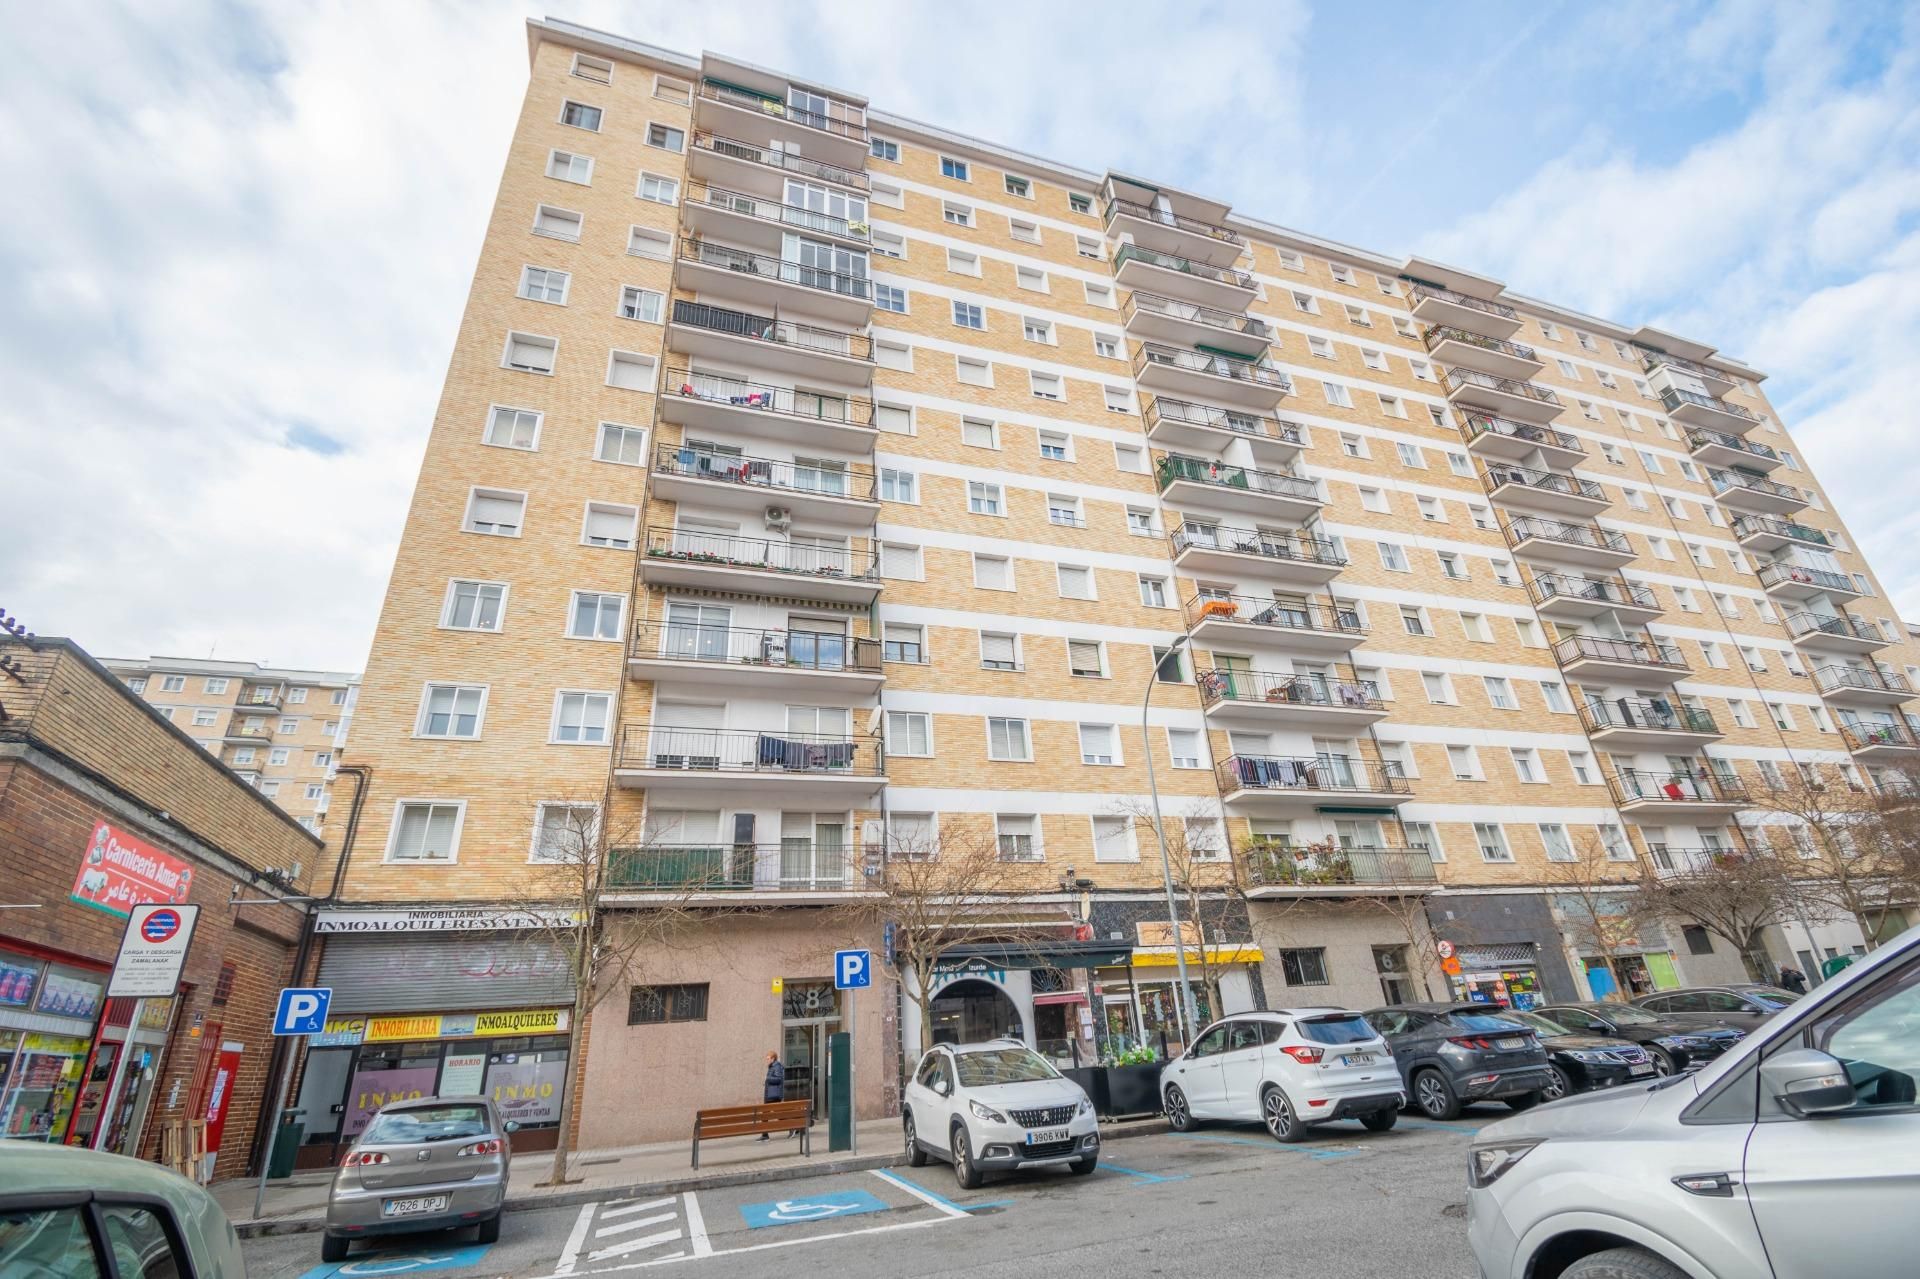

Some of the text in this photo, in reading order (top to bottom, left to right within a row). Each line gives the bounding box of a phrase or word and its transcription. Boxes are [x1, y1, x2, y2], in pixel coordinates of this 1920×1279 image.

[154, 862, 180, 889] Amar
[408, 911, 484, 920] INMOBILIARIA
[843, 955, 863, 984] P
[1382, 953, 1393, 970] 6
[806, 989, 820, 1009] 8
[284, 994, 319, 1029] P
[324, 1018, 364, 1035] NMO
[371, 1017, 437, 1038] INMOBILIARIA
[477, 1013, 558, 1030] INMOALQUILERES
[449, 1058, 480, 1067] HORARIO
[494, 1083, 553, 1101] INMO
[1034, 1130, 1054, 1143] 3906
[393, 1197, 442, 1213] 7626 DPJ
